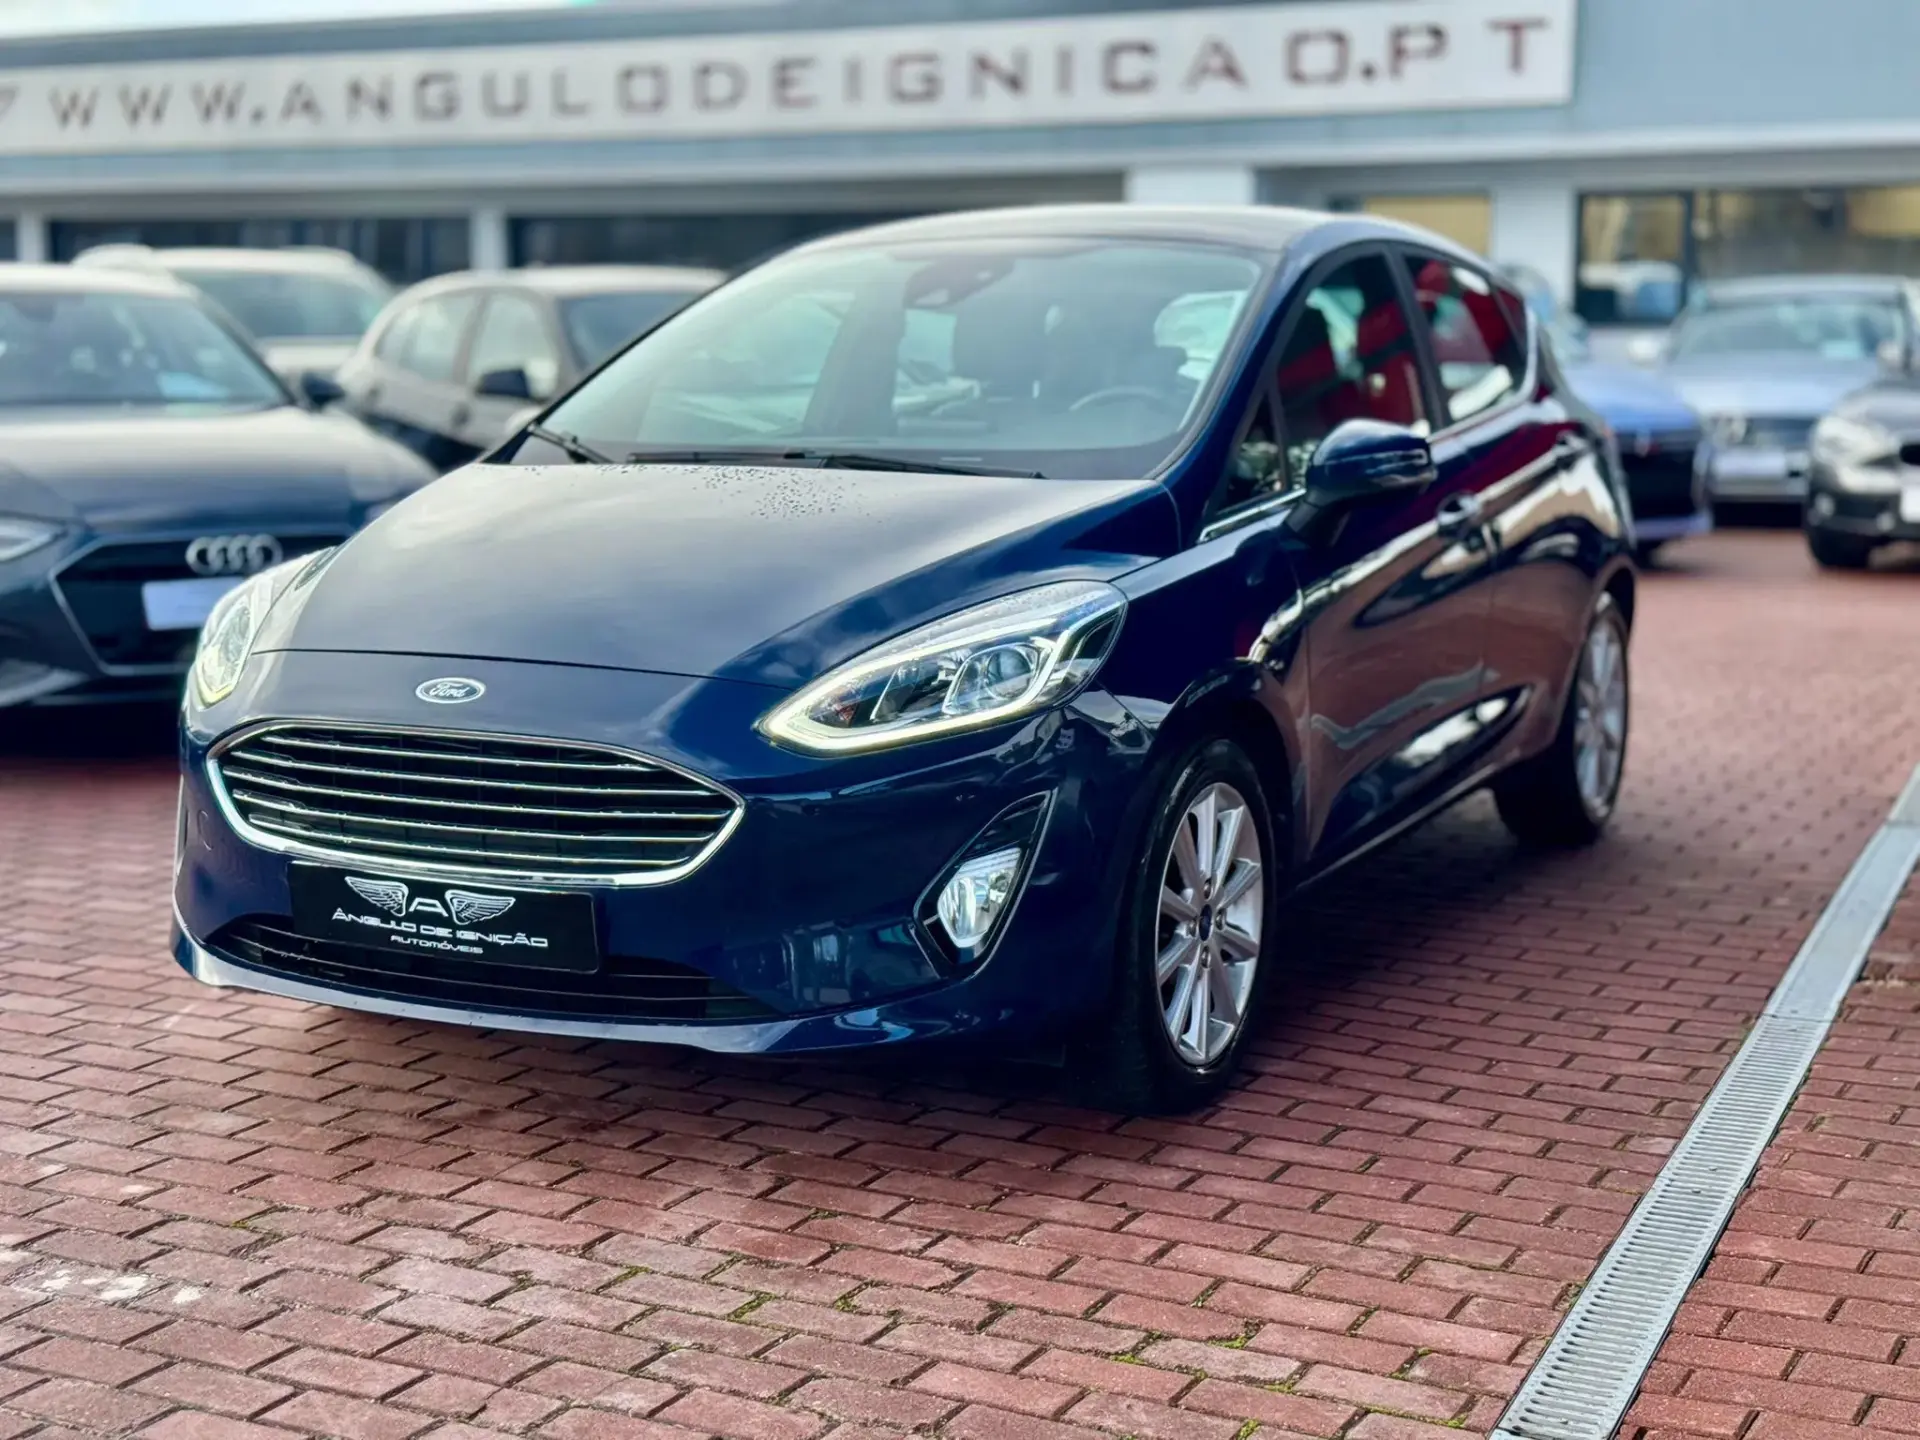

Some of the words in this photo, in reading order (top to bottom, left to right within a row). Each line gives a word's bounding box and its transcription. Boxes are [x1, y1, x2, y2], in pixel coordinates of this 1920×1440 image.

[429, 682, 471, 698] Ford
[332, 907, 417, 932] ÂNGULO
[420, 925, 453, 938] DE
[456, 930, 548, 947] IGNIÇÃO
